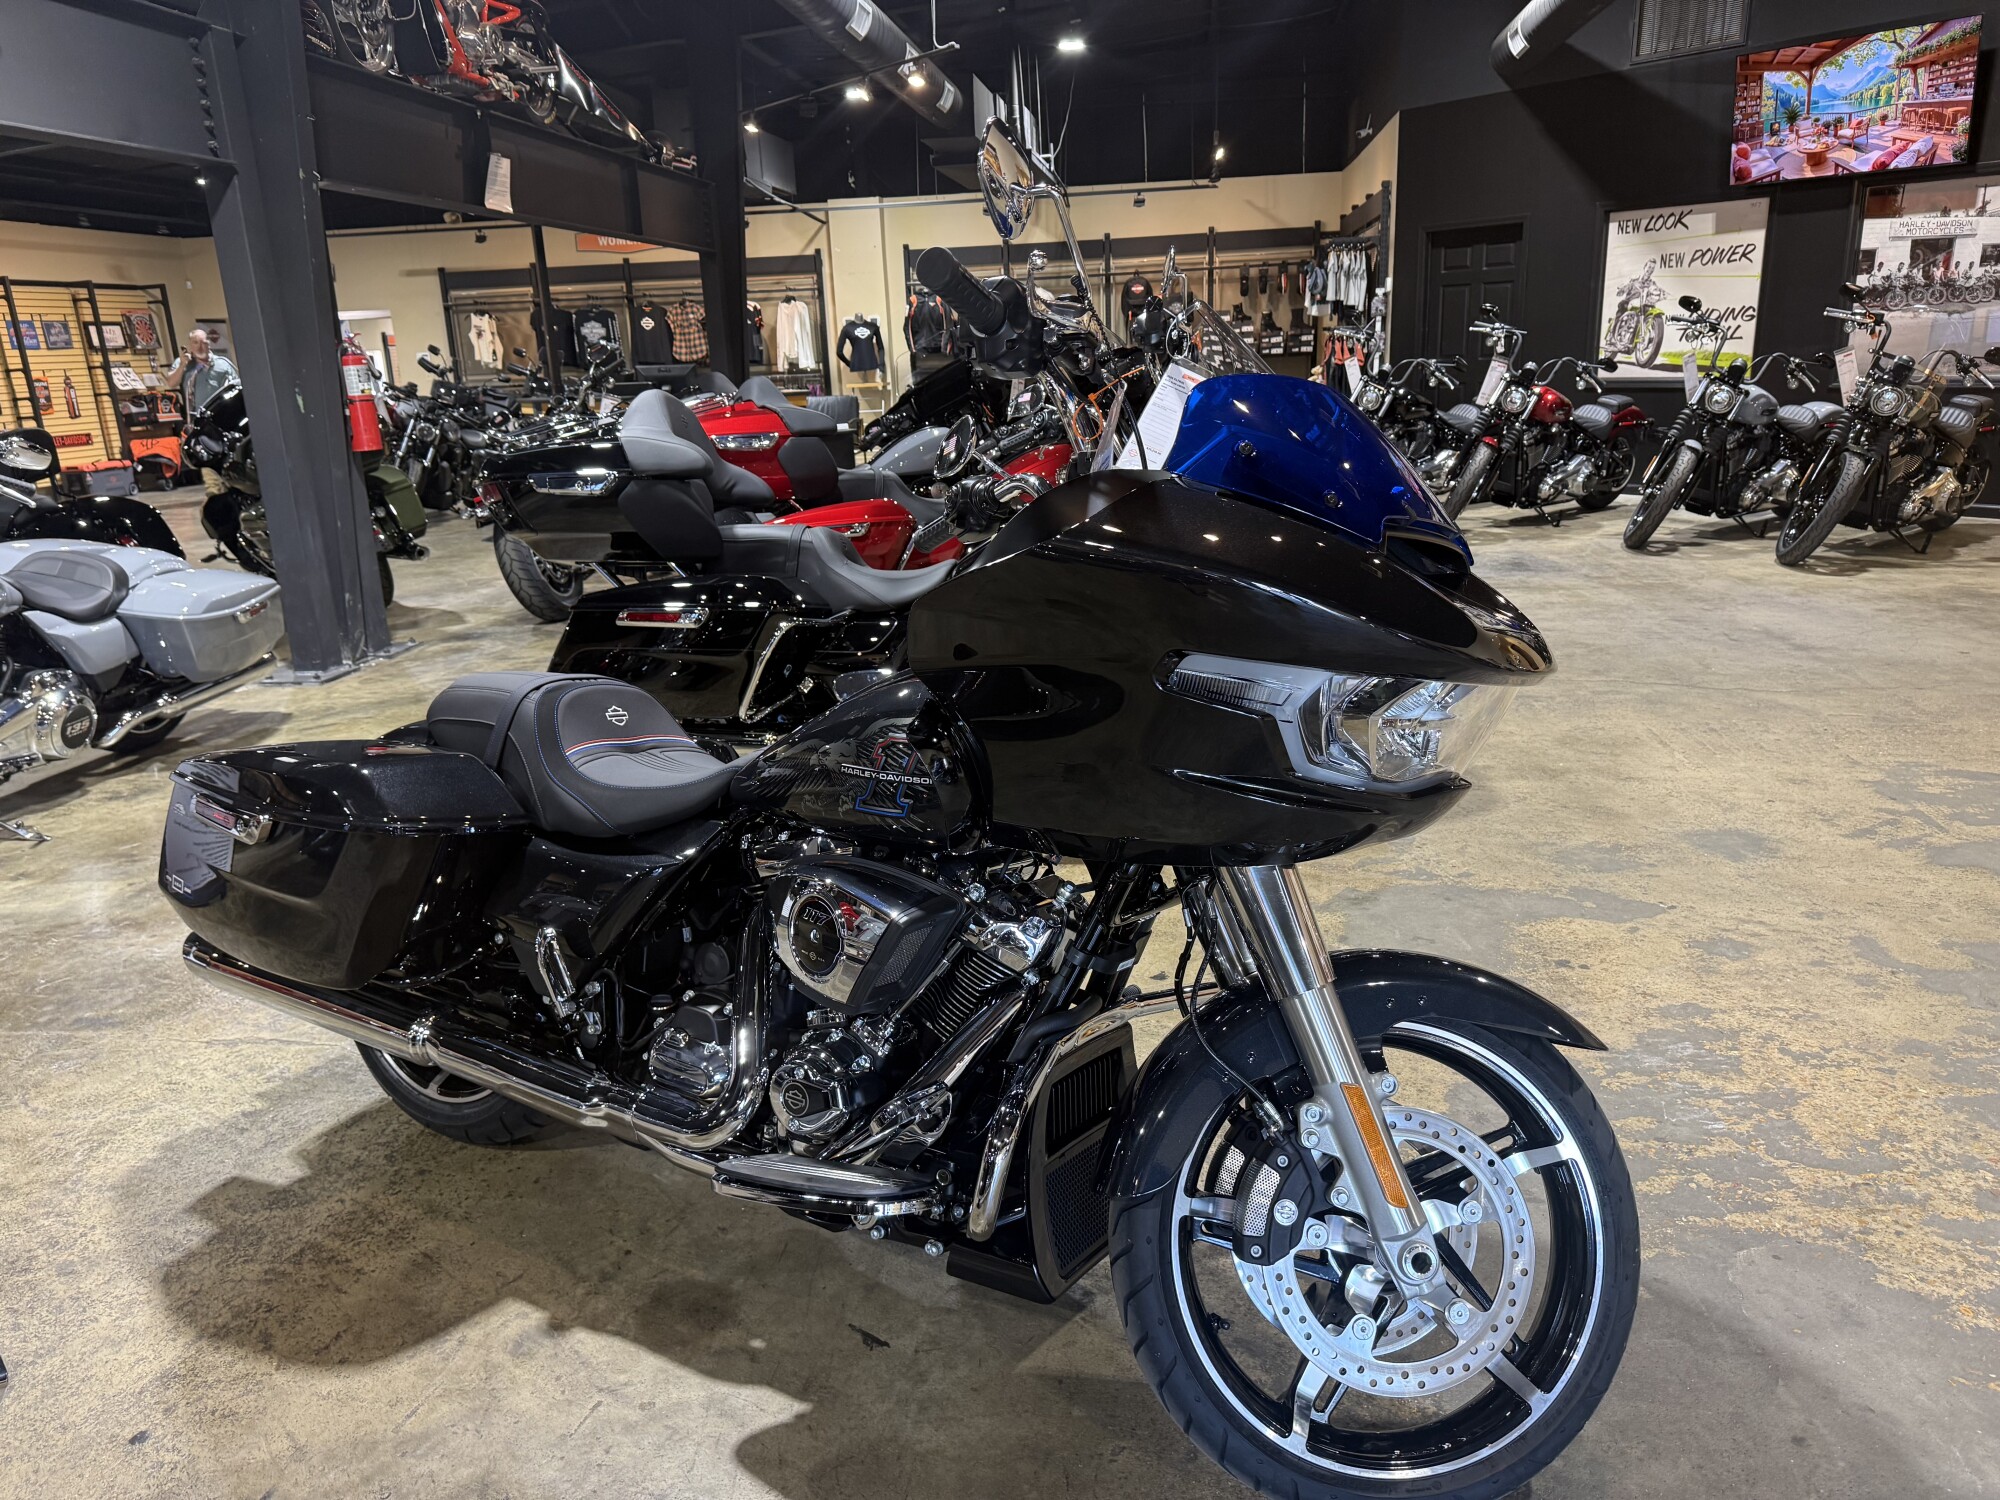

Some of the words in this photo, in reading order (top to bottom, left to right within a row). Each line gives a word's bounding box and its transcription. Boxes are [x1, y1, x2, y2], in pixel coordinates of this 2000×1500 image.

[1617, 218, 1642, 235] NEW
[1644, 209, 1693, 233] LOOK
[1900, 219, 1974, 229] HARLEY-DAVIDSON
[1905, 226, 1965, 236] MOTORCYCLES
[597, 235, 642, 246] WOM
[1659, 252, 1686, 269] NEW
[1688, 243, 1757, 268] POWER
[1688, 305, 1757, 323] IDING
[803, 906, 832, 926] 117
